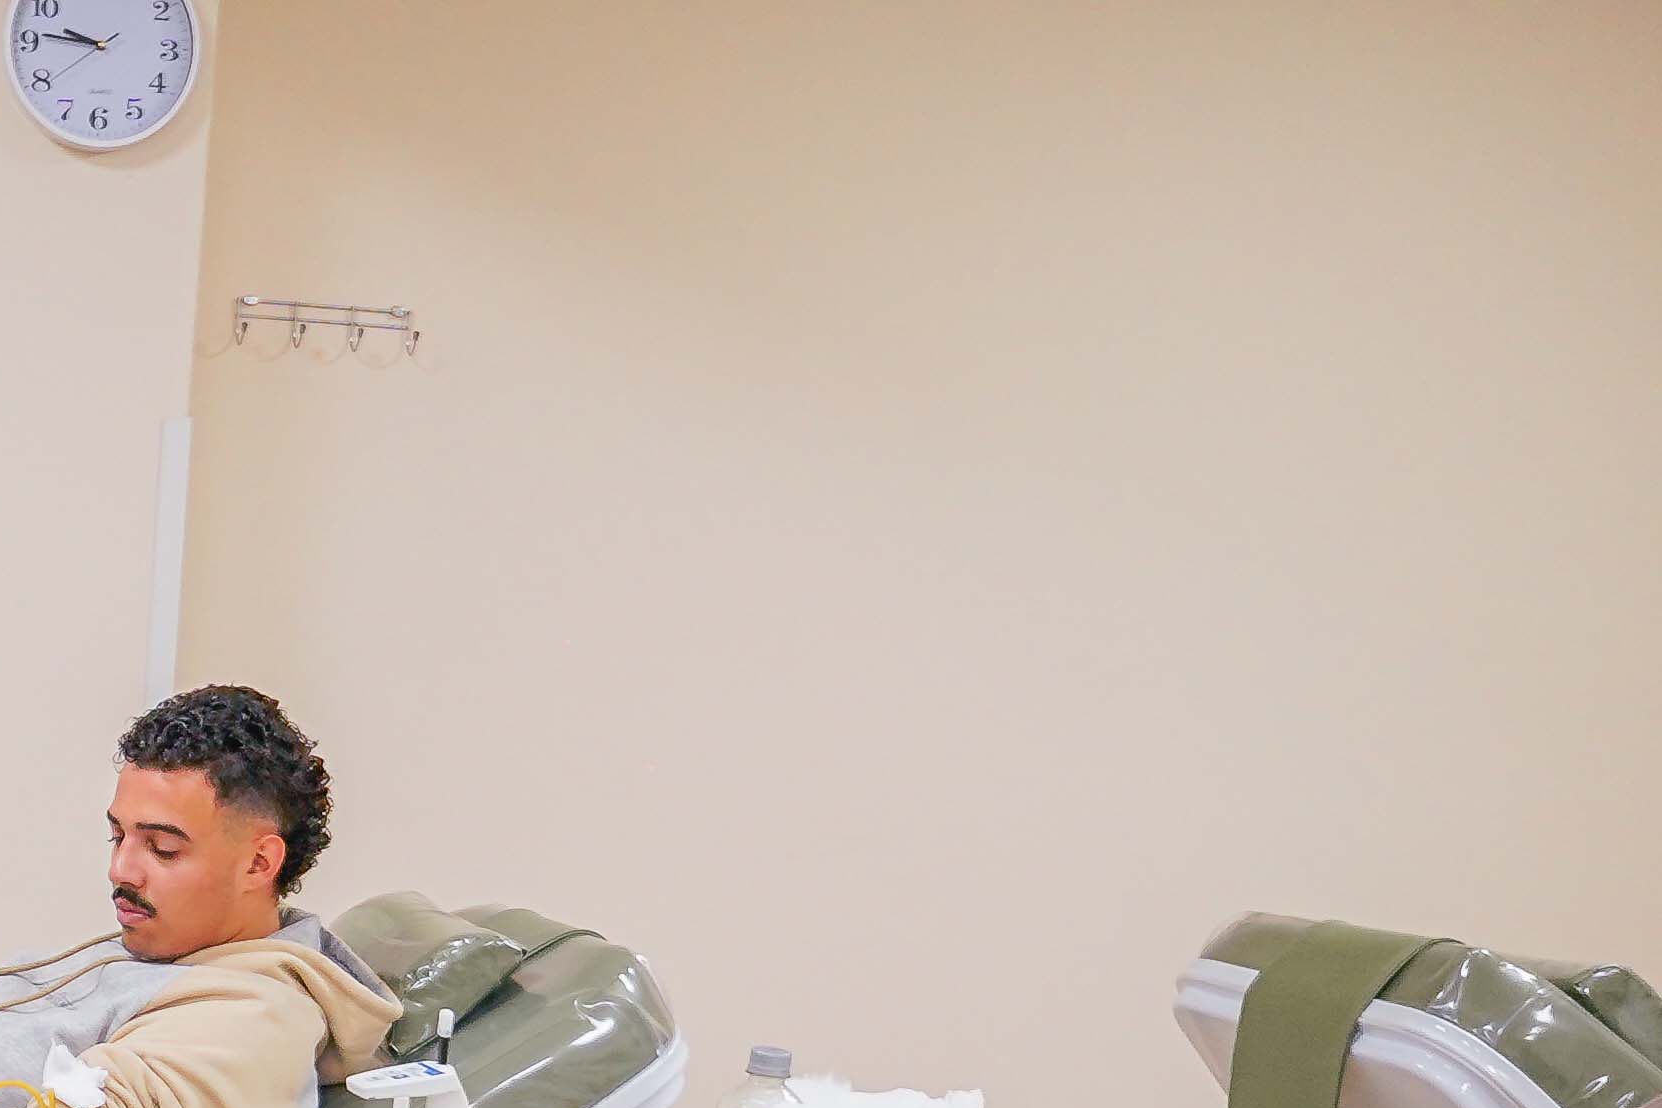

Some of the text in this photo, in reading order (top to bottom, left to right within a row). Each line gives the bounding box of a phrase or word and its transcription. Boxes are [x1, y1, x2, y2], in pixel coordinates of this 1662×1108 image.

[33, 0, 59, 18] 10
[153, 1, 170, 21] 2
[20, 30, 39, 53] 9
[160, 40, 179, 61] 3
[31, 69, 50, 92] 8
[149, 73, 166, 93] 4
[57, 100, 74, 120] 7
[90, 107, 108, 130] 6
[125, 99, 143, 120] 5
